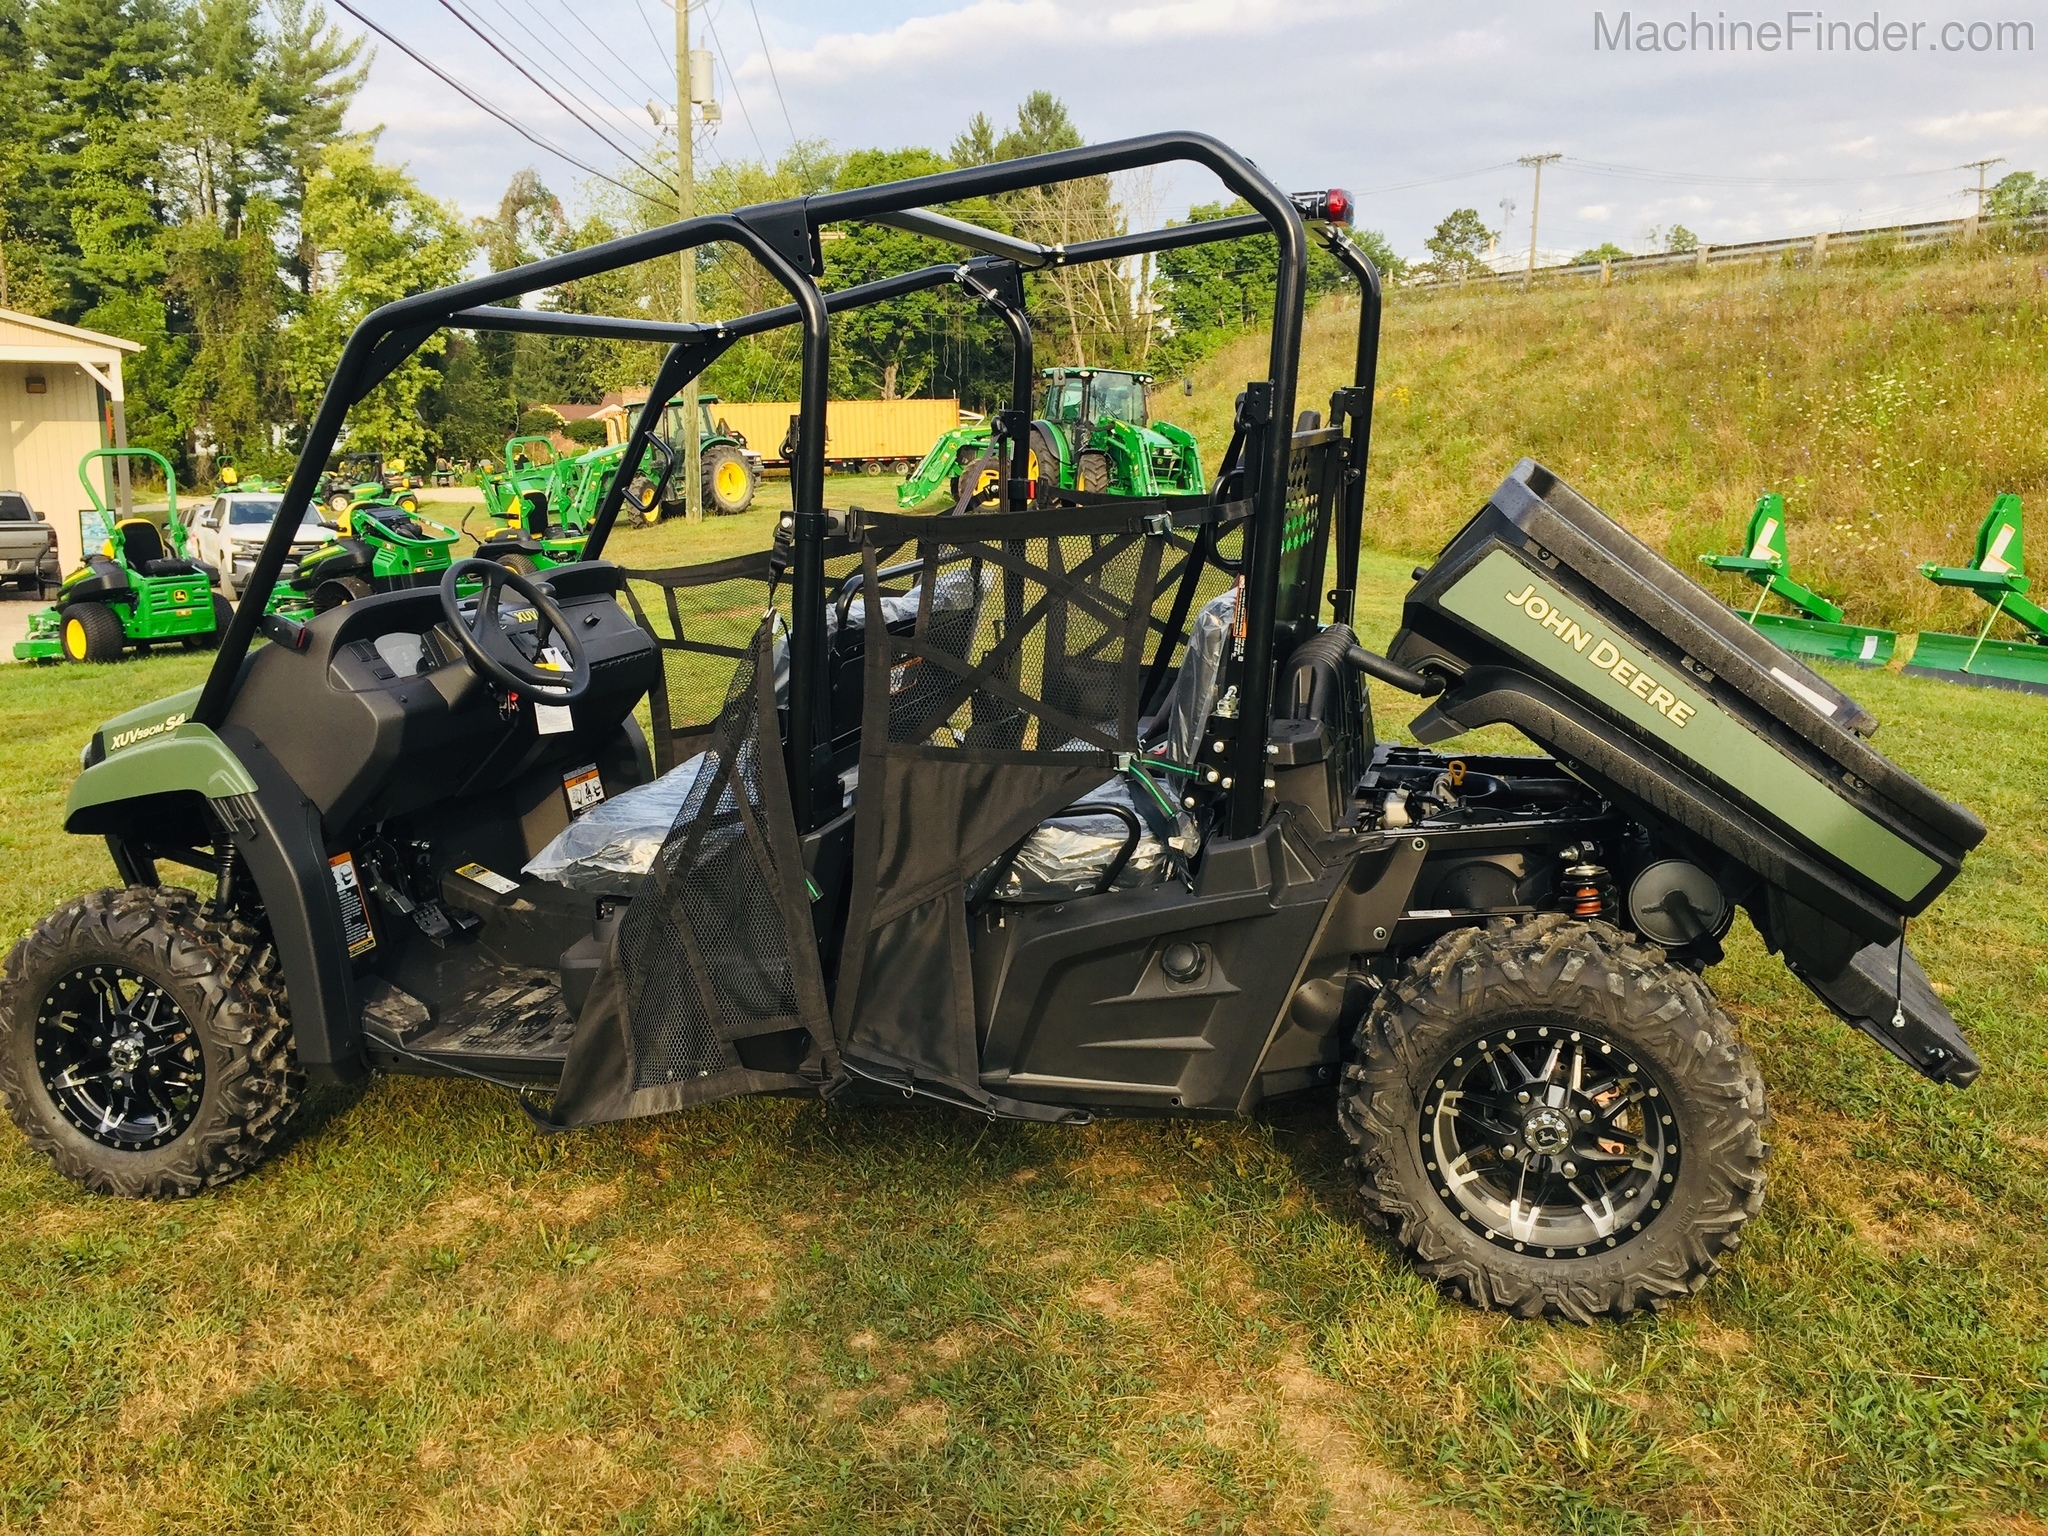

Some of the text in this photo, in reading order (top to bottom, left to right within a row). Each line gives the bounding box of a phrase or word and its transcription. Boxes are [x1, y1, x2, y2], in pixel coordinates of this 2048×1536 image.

[514, 609, 539, 623] XUV
[1504, 583, 1697, 728] JOHN DEERE
[165, 712, 187, 732] S4
